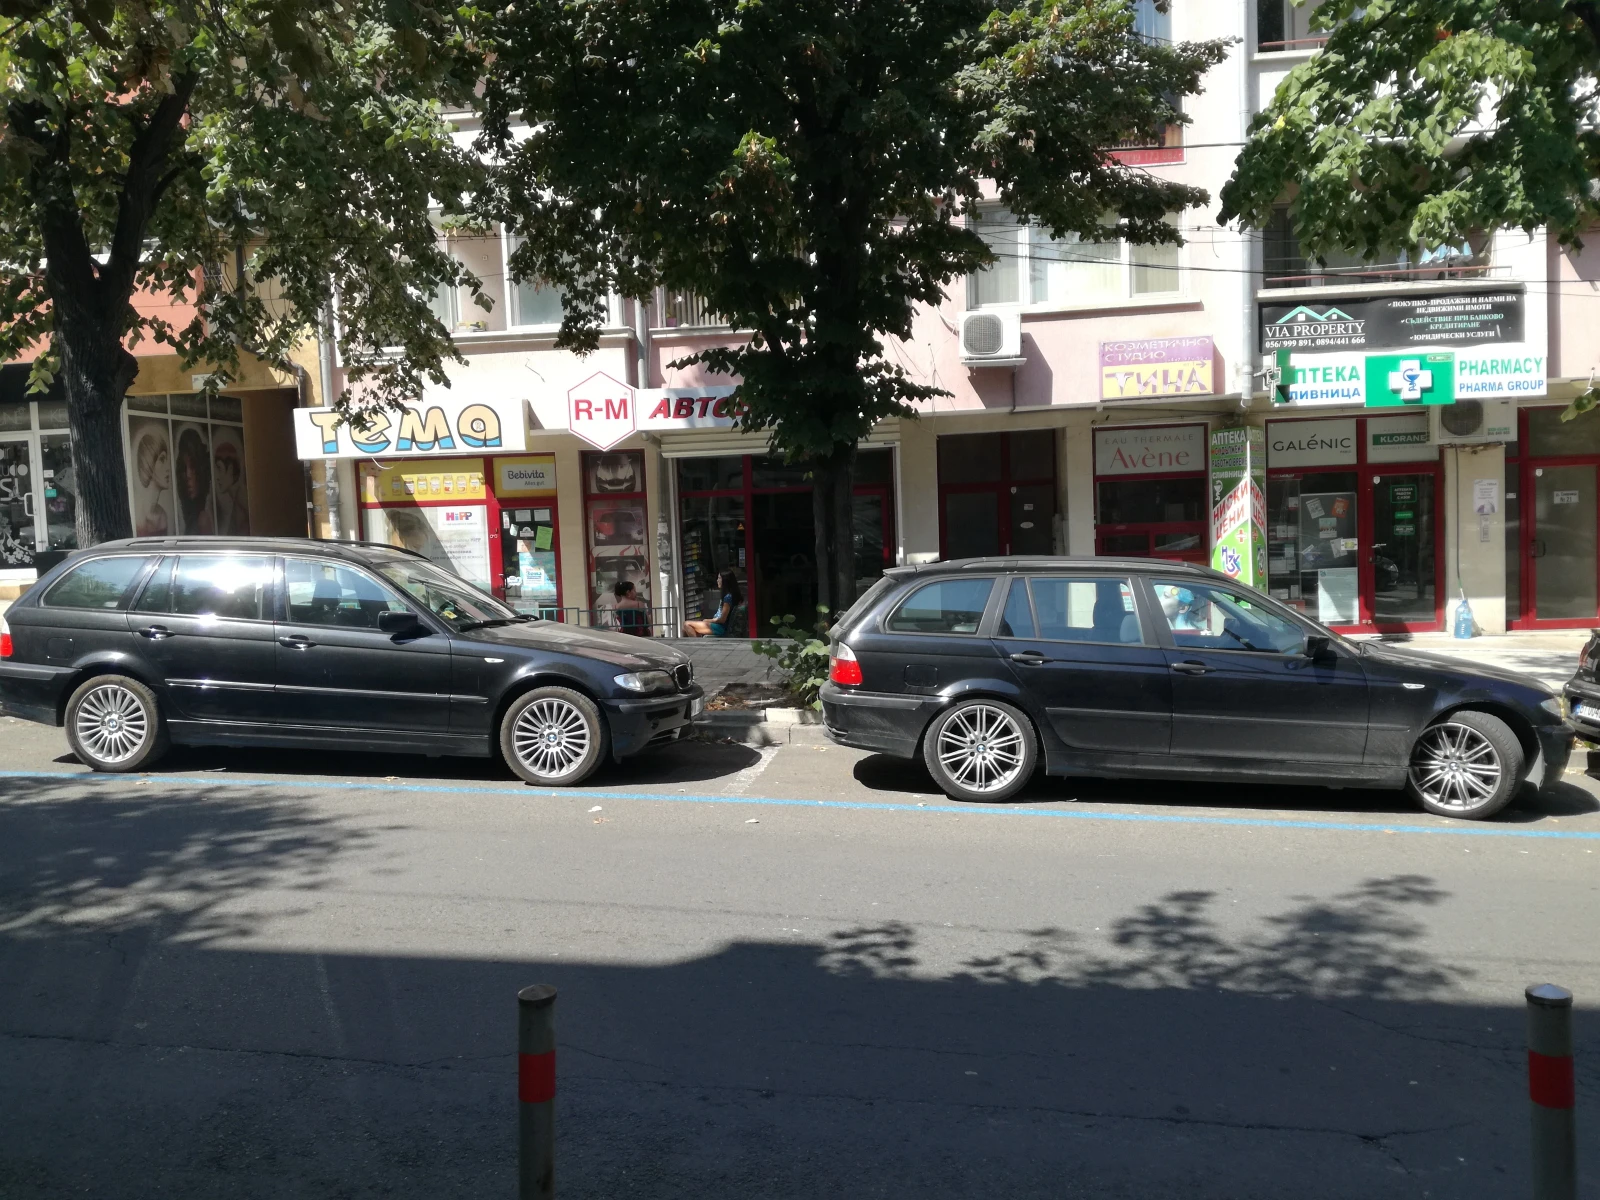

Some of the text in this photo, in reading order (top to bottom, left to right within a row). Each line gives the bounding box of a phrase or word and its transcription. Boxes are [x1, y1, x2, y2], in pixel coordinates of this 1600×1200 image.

[1478, 295, 1504, 303] НАЕМИ
[1416, 303, 1492, 314] НЕДВИЖИМИ ИМОТИ
[1405, 315, 1453, 324] СЪДЕЙСТВИЕ
[1470, 313, 1504, 321] БАНКОВО
[1265, 322, 1365, 338] VIA PROPERTY
[1430, 321, 1481, 330] КРЕДИТИРАНЕ
[1316, 337, 1349, 346] 0894/441
[1351, 336, 1366, 344] 666
[1413, 330, 1495, 341] ЮРИДИЧЕСКИ УСЛУГИ
[1105, 338, 1209, 352] КОЗМЕТИЧНО
[1105, 350, 1166, 363] СТУДИО
[1459, 357, 1543, 376] PHARMACY
[1295, 365, 1361, 384] ПТЕКА
[1105, 367, 1209, 396] ТИНА
[1459, 379, 1544, 393] PHARMA GROUP
[1289, 387, 1361, 400] ЛИВНИЦА
[574, 398, 629, 421] R-M
[1105, 433, 1194, 445] EAU THERMALE
[1211, 430, 1247, 446] АПТЕКА
[1380, 434, 1426, 443] KLORANE
[1110, 446, 1190, 469] Avène
[507, 470, 545, 480] Bebivita
[1213, 481, 1248, 526] НИСКИ
[445, 511, 473, 521] HiPP
[1215, 503, 1245, 541] ЦЕНИ
